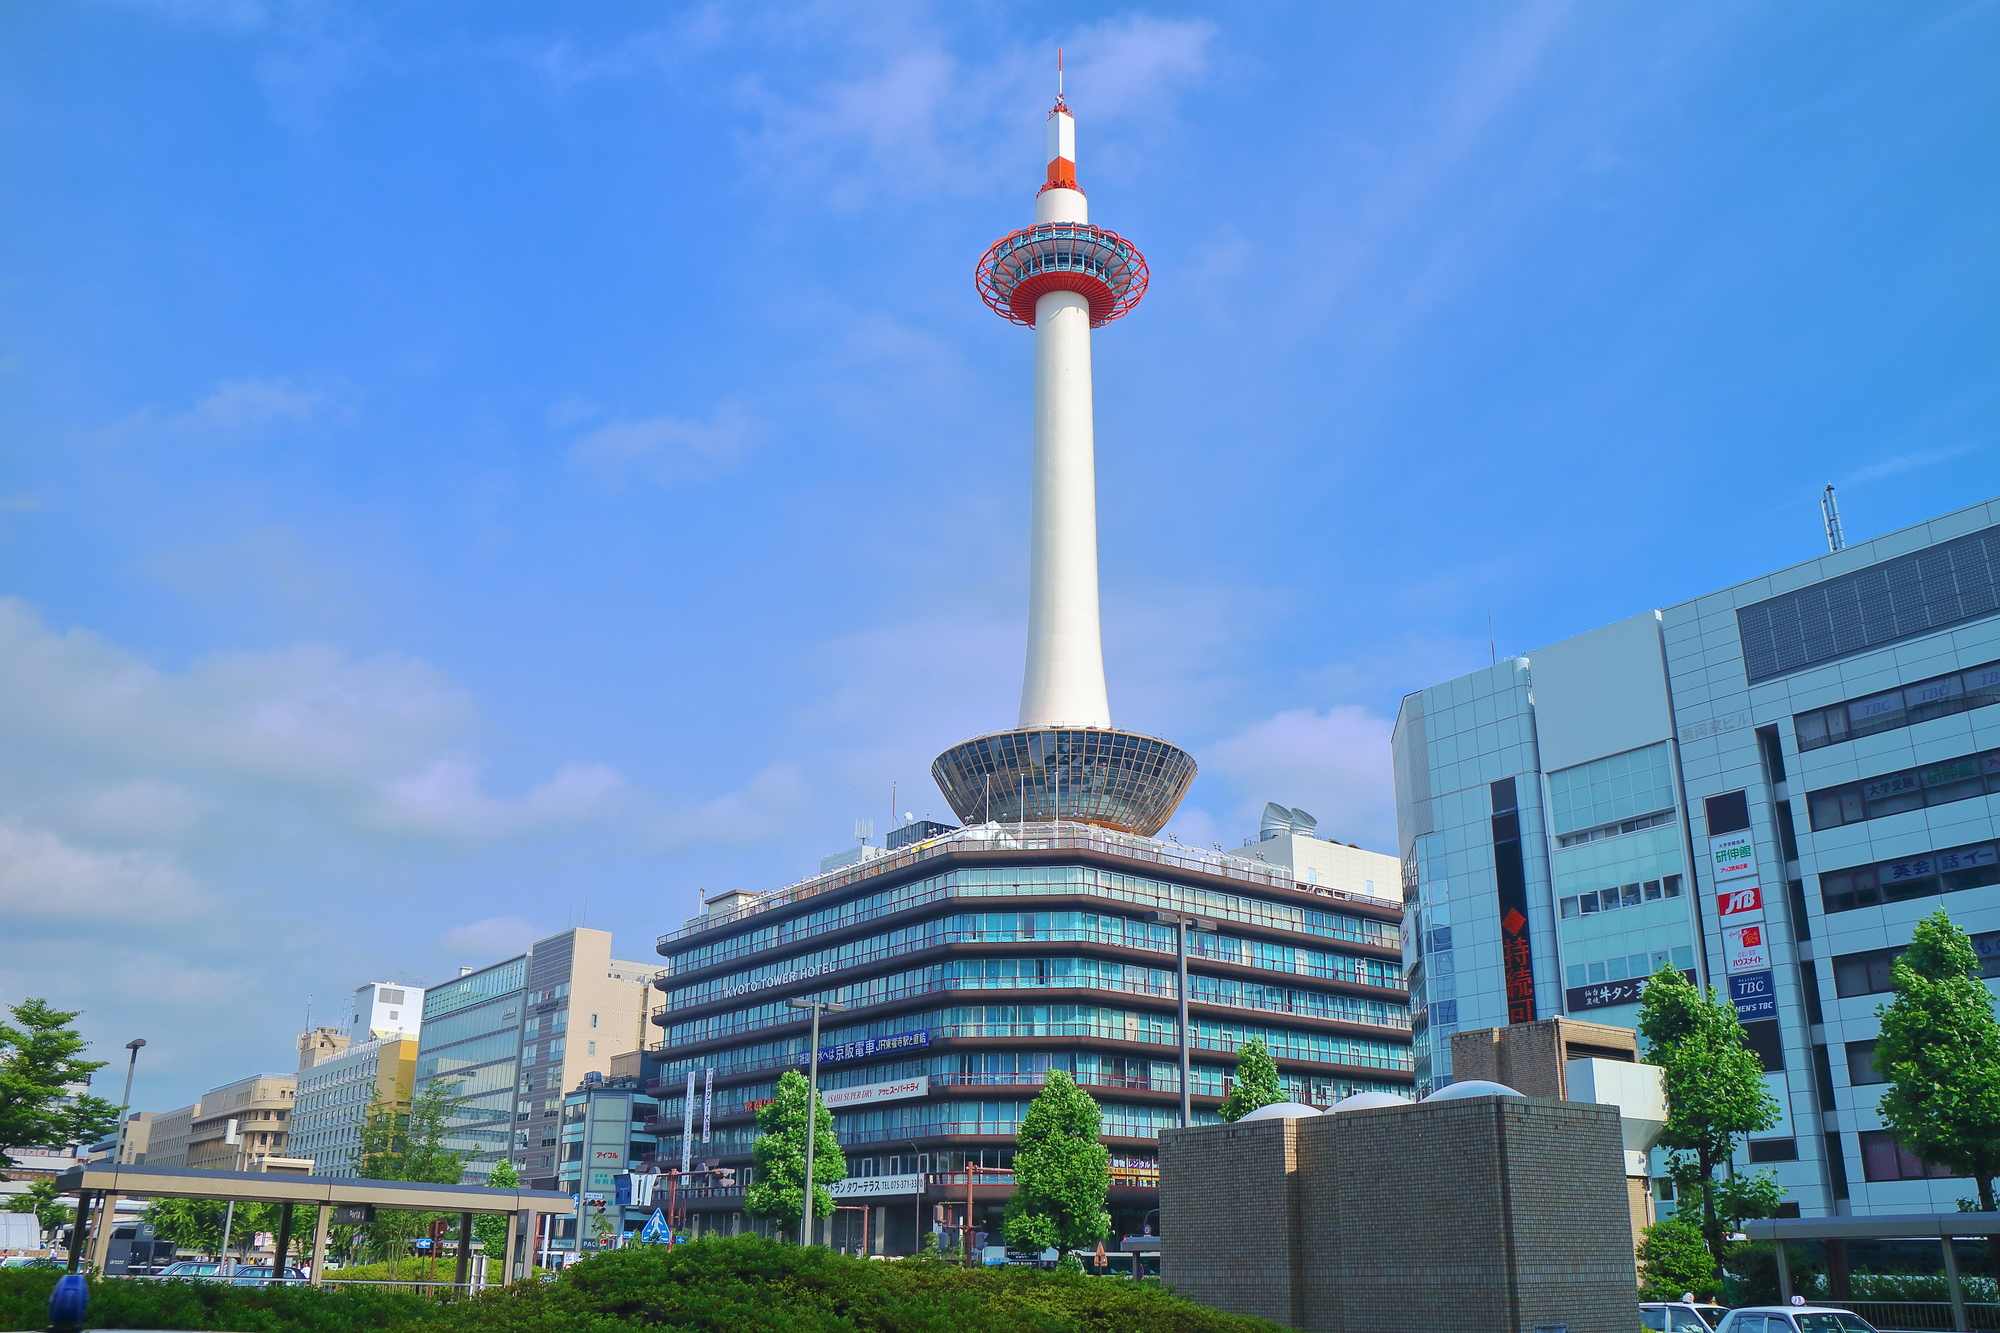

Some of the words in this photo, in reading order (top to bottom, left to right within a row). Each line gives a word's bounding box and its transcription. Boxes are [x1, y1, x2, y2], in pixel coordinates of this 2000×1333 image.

[1715, 845, 1751, 863] 研伸館
[1725, 890, 1755, 915] JTB
[724, 982, 758, 998] KYOTO
[761, 971, 797, 988] TOWER
[799, 961, 836, 979] HOTEL
[1738, 981, 1765, 994] TBC
[1735, 1002, 1757, 1013] MEN'S
[1759, 1001, 1773, 1010] TBC
[846, 1180, 880, 1193] タワーテラス
[890, 1178, 924, 1190] 075-371-330
